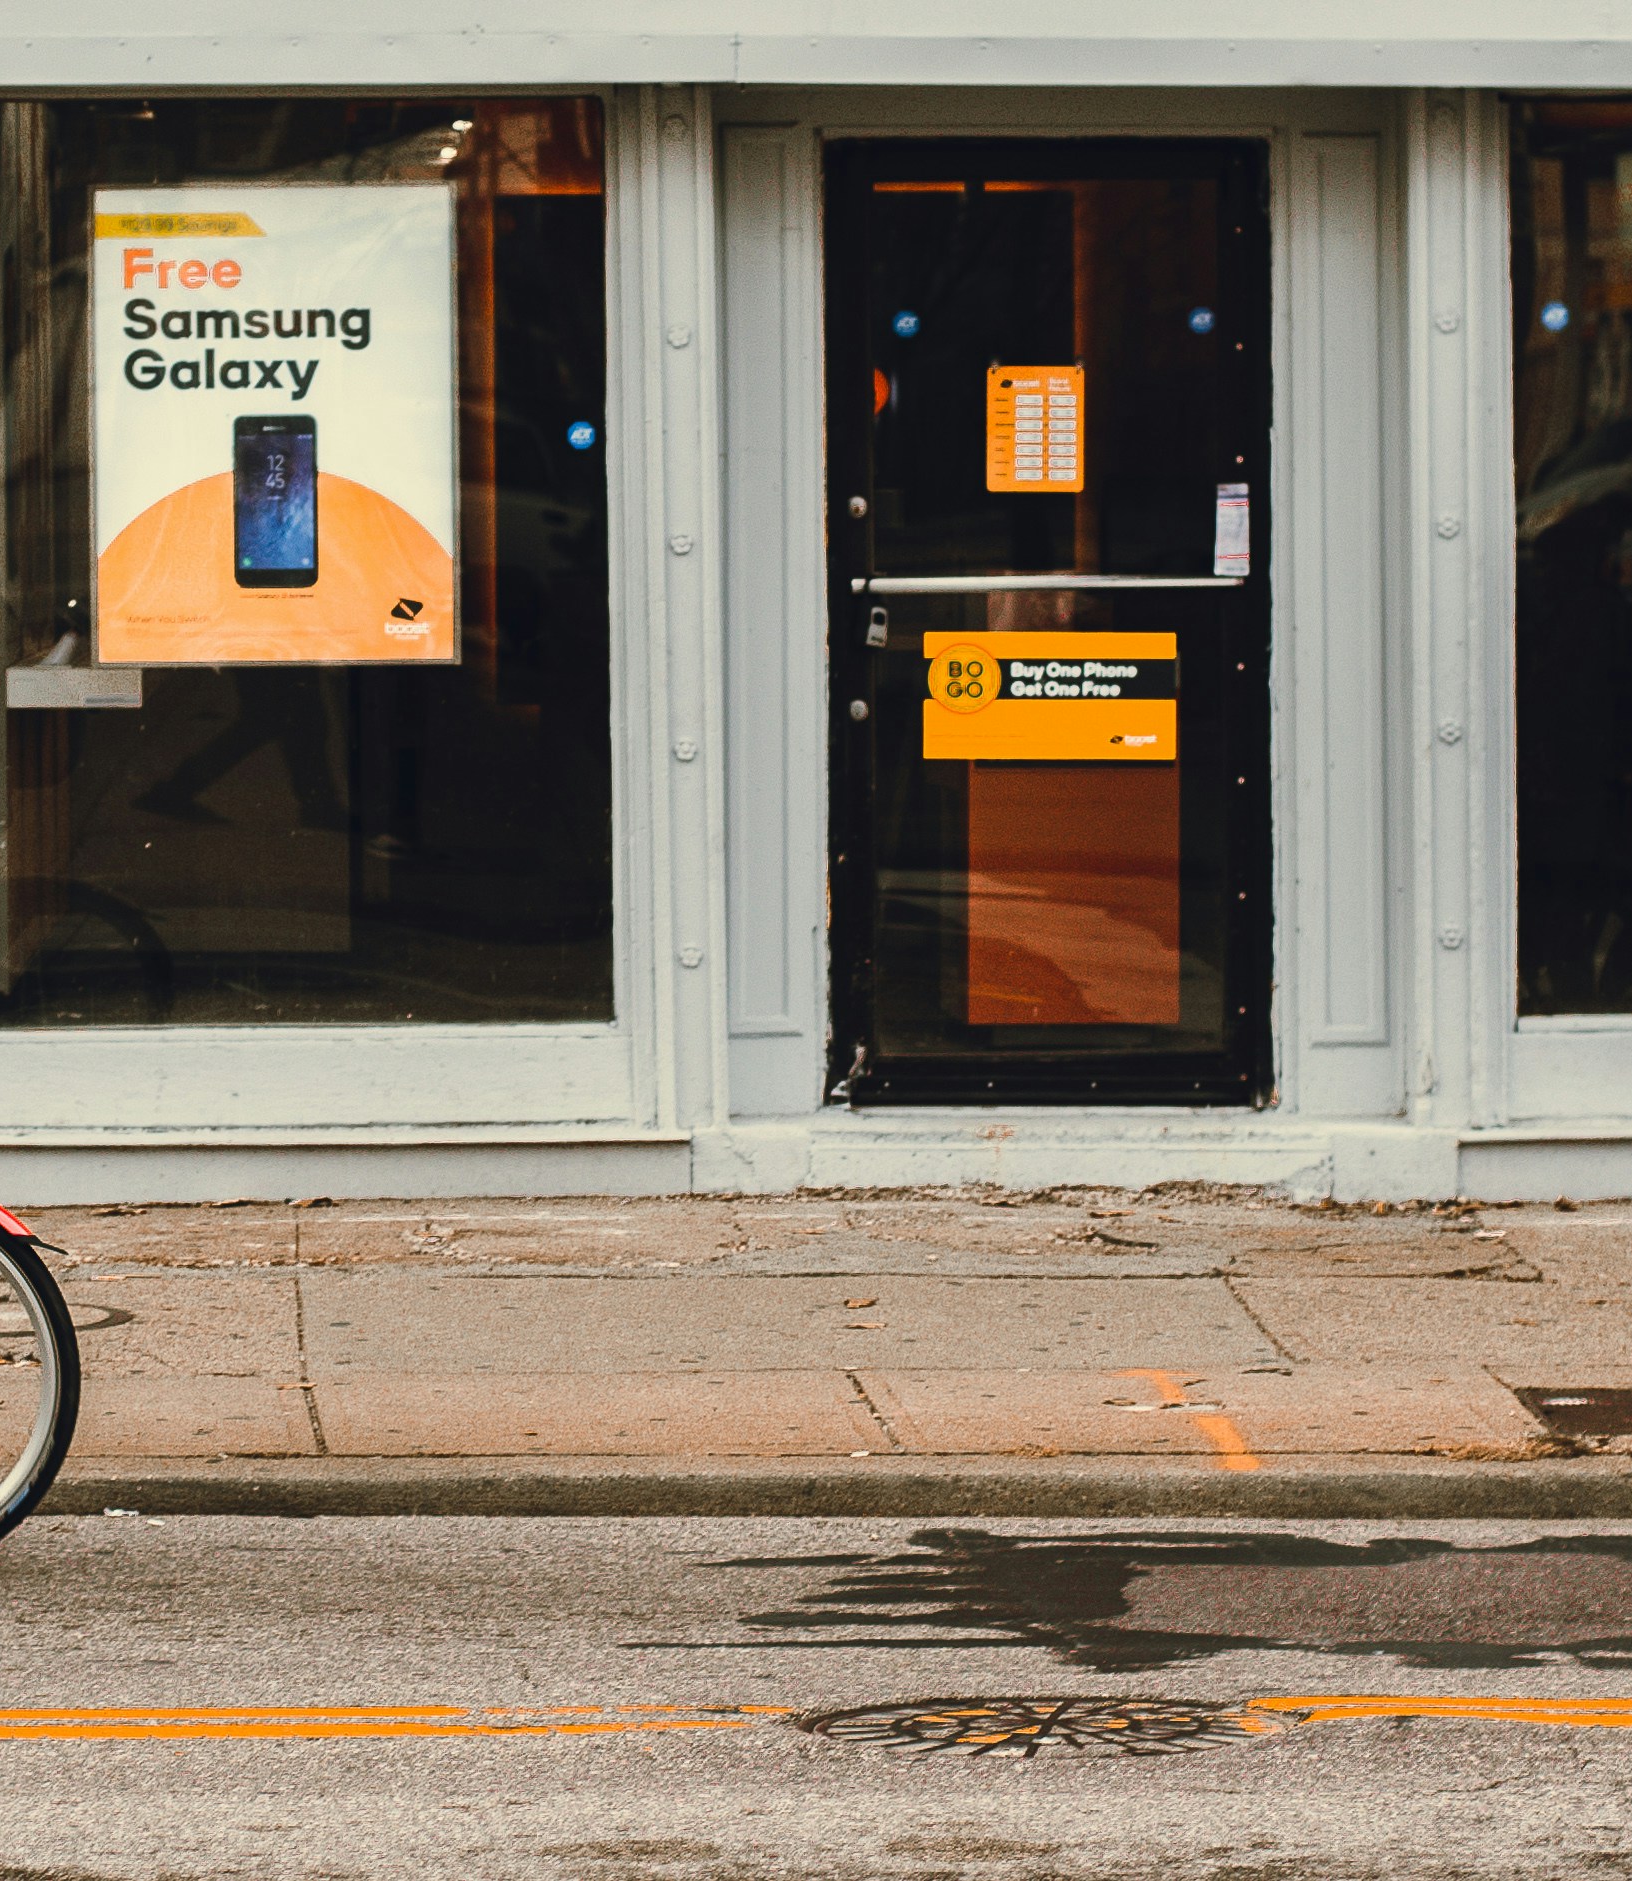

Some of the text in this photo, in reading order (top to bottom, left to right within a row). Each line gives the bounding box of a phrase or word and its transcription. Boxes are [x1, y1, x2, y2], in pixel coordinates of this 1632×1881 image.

[123, 248, 243, 290] Free
[123, 298, 372, 350] Samsung
[123, 349, 320, 401] Galaxy
[266, 454, 285, 471] 12
[265, 472, 286, 489] 45
[948, 661, 984, 678] BO
[1010, 661, 1138, 682] Buy One Phone
[946, 681, 984, 698] GO
[1010, 680, 1122, 697] Get One Free
